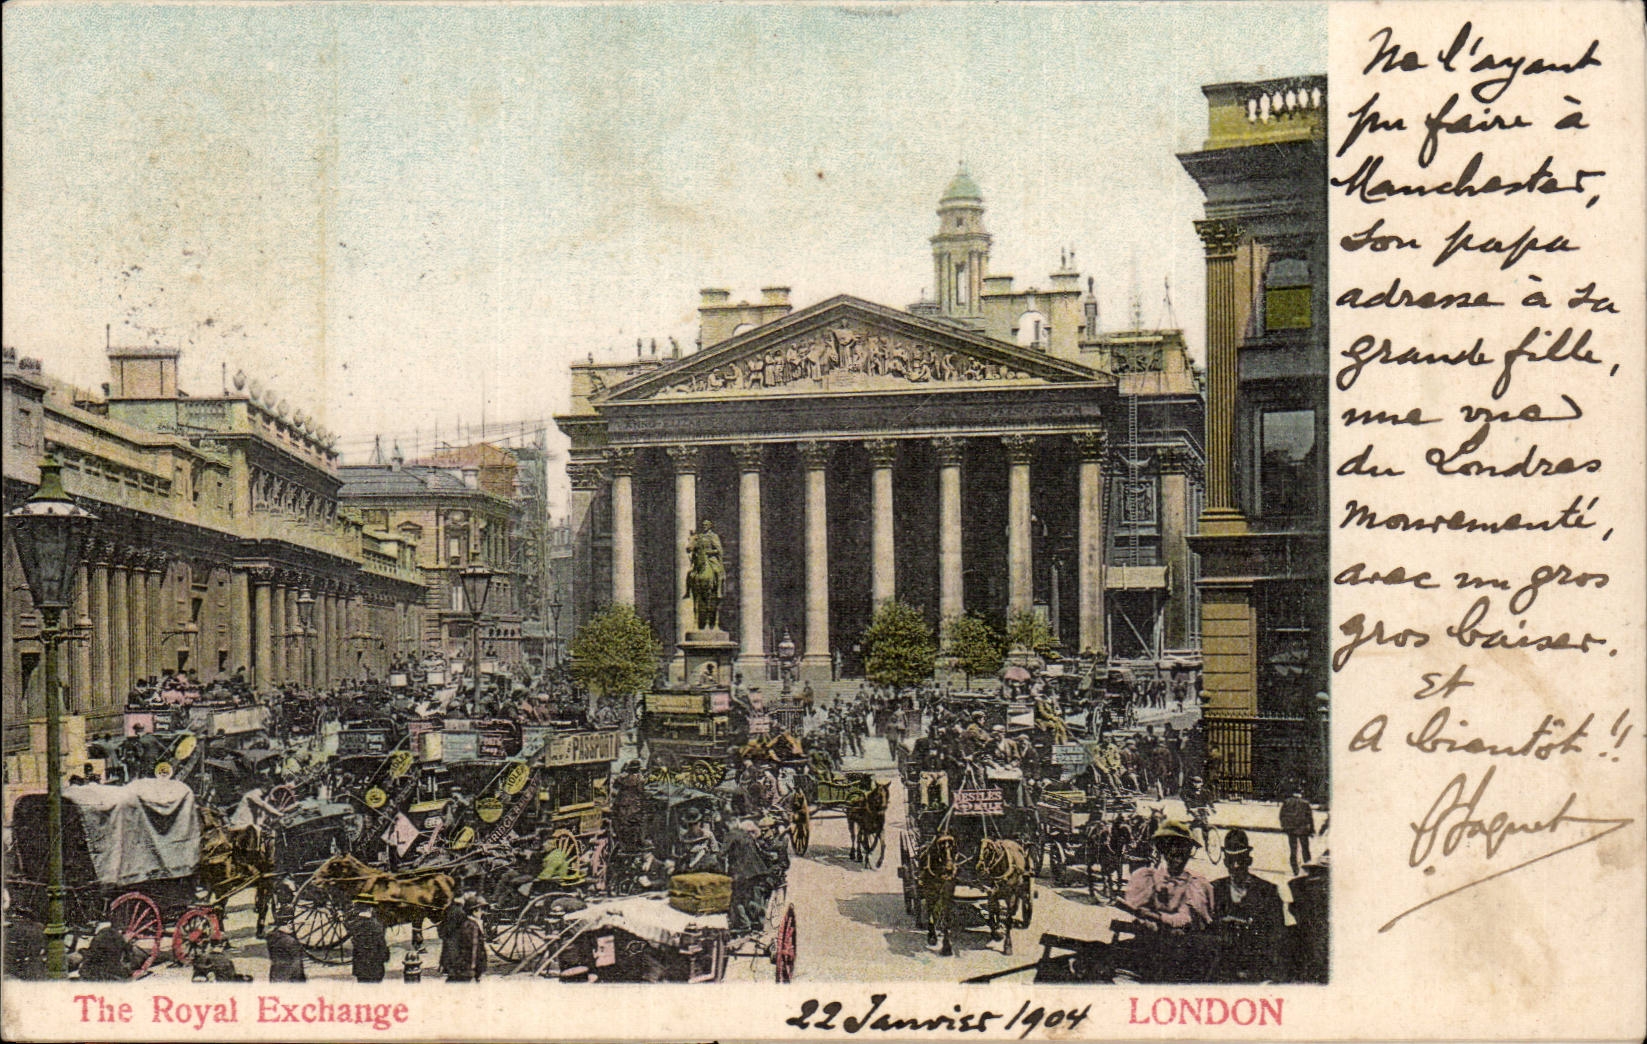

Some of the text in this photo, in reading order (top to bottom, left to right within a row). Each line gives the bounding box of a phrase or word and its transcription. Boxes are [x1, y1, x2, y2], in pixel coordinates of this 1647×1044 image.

[1363, 21, 1602, 104] Ne l'ayant
[1336, 92, 1589, 169] pu faire à
[1332, 152, 1606, 208] Manchester,
[1433, 220, 1580, 271] papa
[1336, 278, 1505, 309] adresse
[1521, 275, 1552, 308] à
[1336, 327, 1619, 400] grande fille,
[1341, 394, 1583, 427] une vue
[1425, 423, 1602, 477] Londres
[1334, 563, 1609, 615] avec un gros
[1332, 596, 1617, 673] gros baiser.
[1414, 664, 1474, 700] Et
[786, 994, 1091, 1037] 22 Janvier 1904
